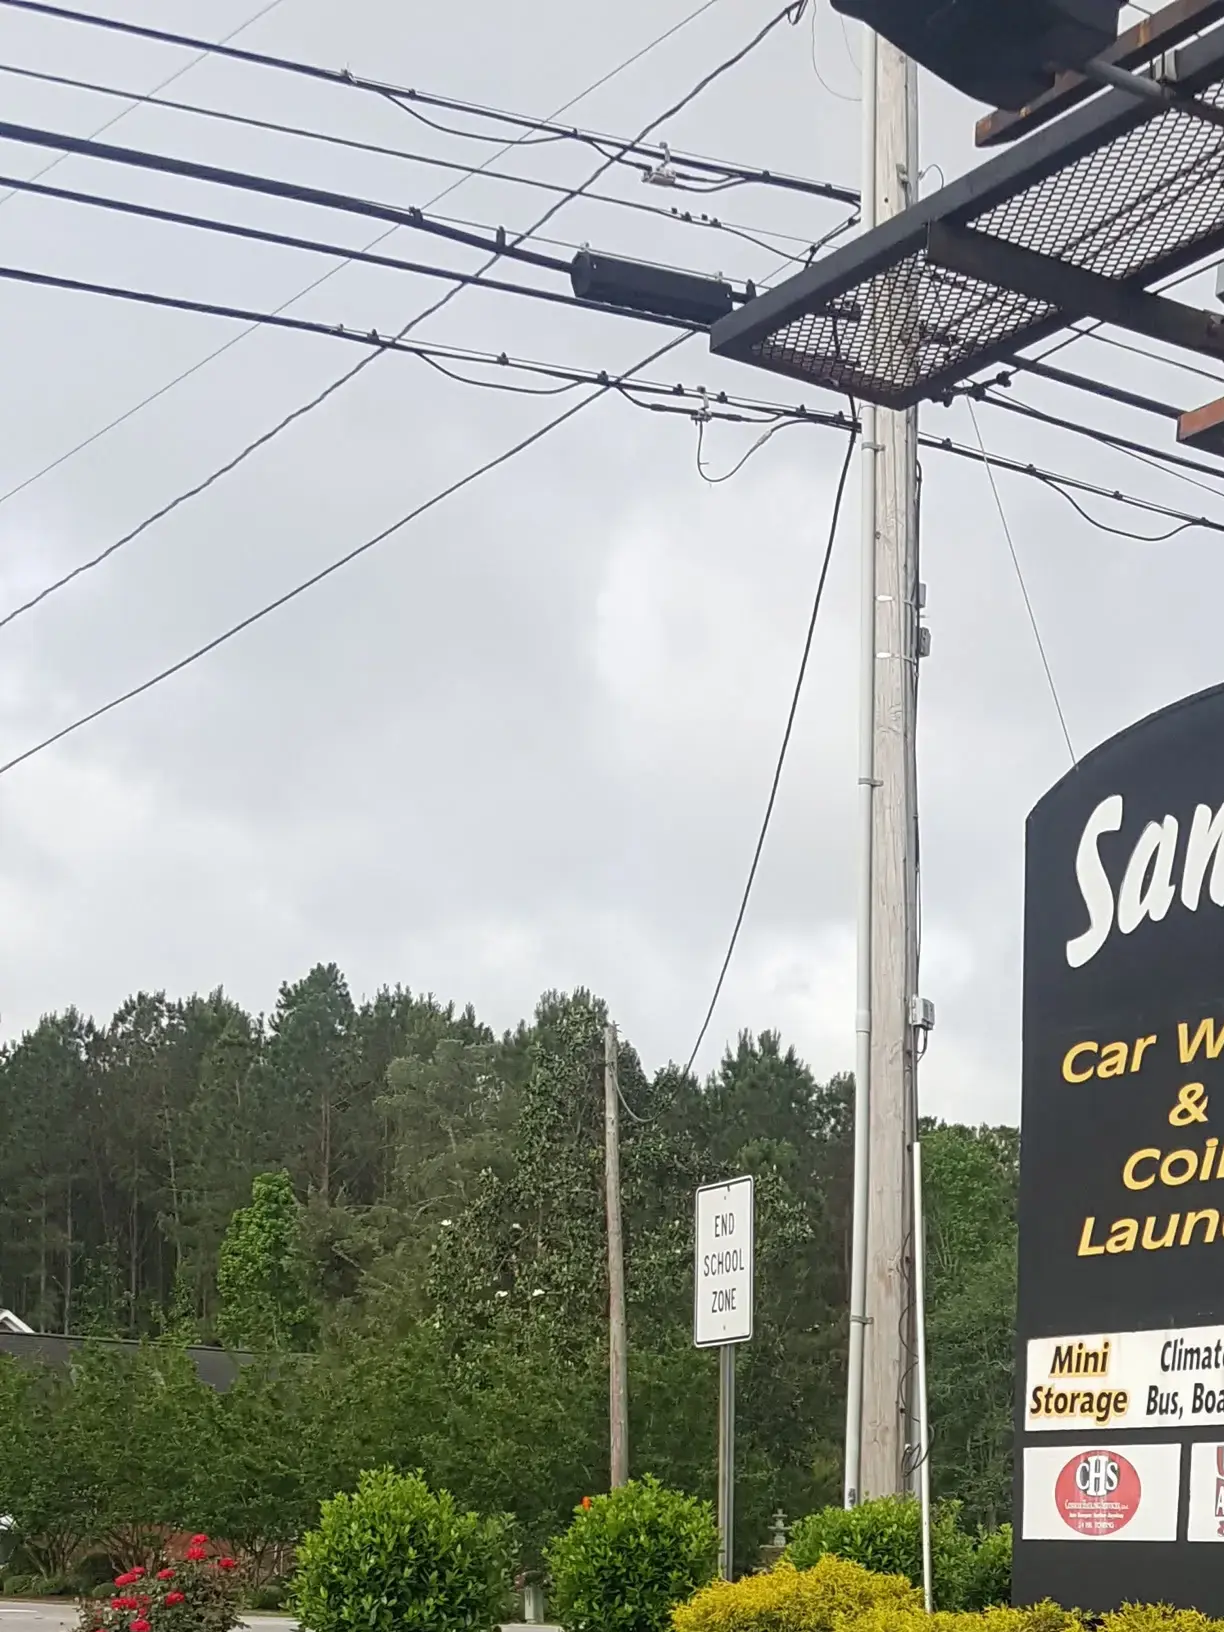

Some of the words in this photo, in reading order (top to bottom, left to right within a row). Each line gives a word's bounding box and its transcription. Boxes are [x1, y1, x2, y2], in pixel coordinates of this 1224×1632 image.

[1061, 1034, 1156, 1084] Car
[1168, 1082, 1208, 1127] &
[714, 1212, 735, 1238] END
[703, 1248, 745, 1277] SCHOOL
[711, 1288, 737, 1313] ZONE
[1050, 1341, 1110, 1375] Mini
[1030, 1386, 1128, 1422] Storage
[1146, 1385, 1183, 1419] Bus,
[1075, 1455, 1119, 1496] CHS
